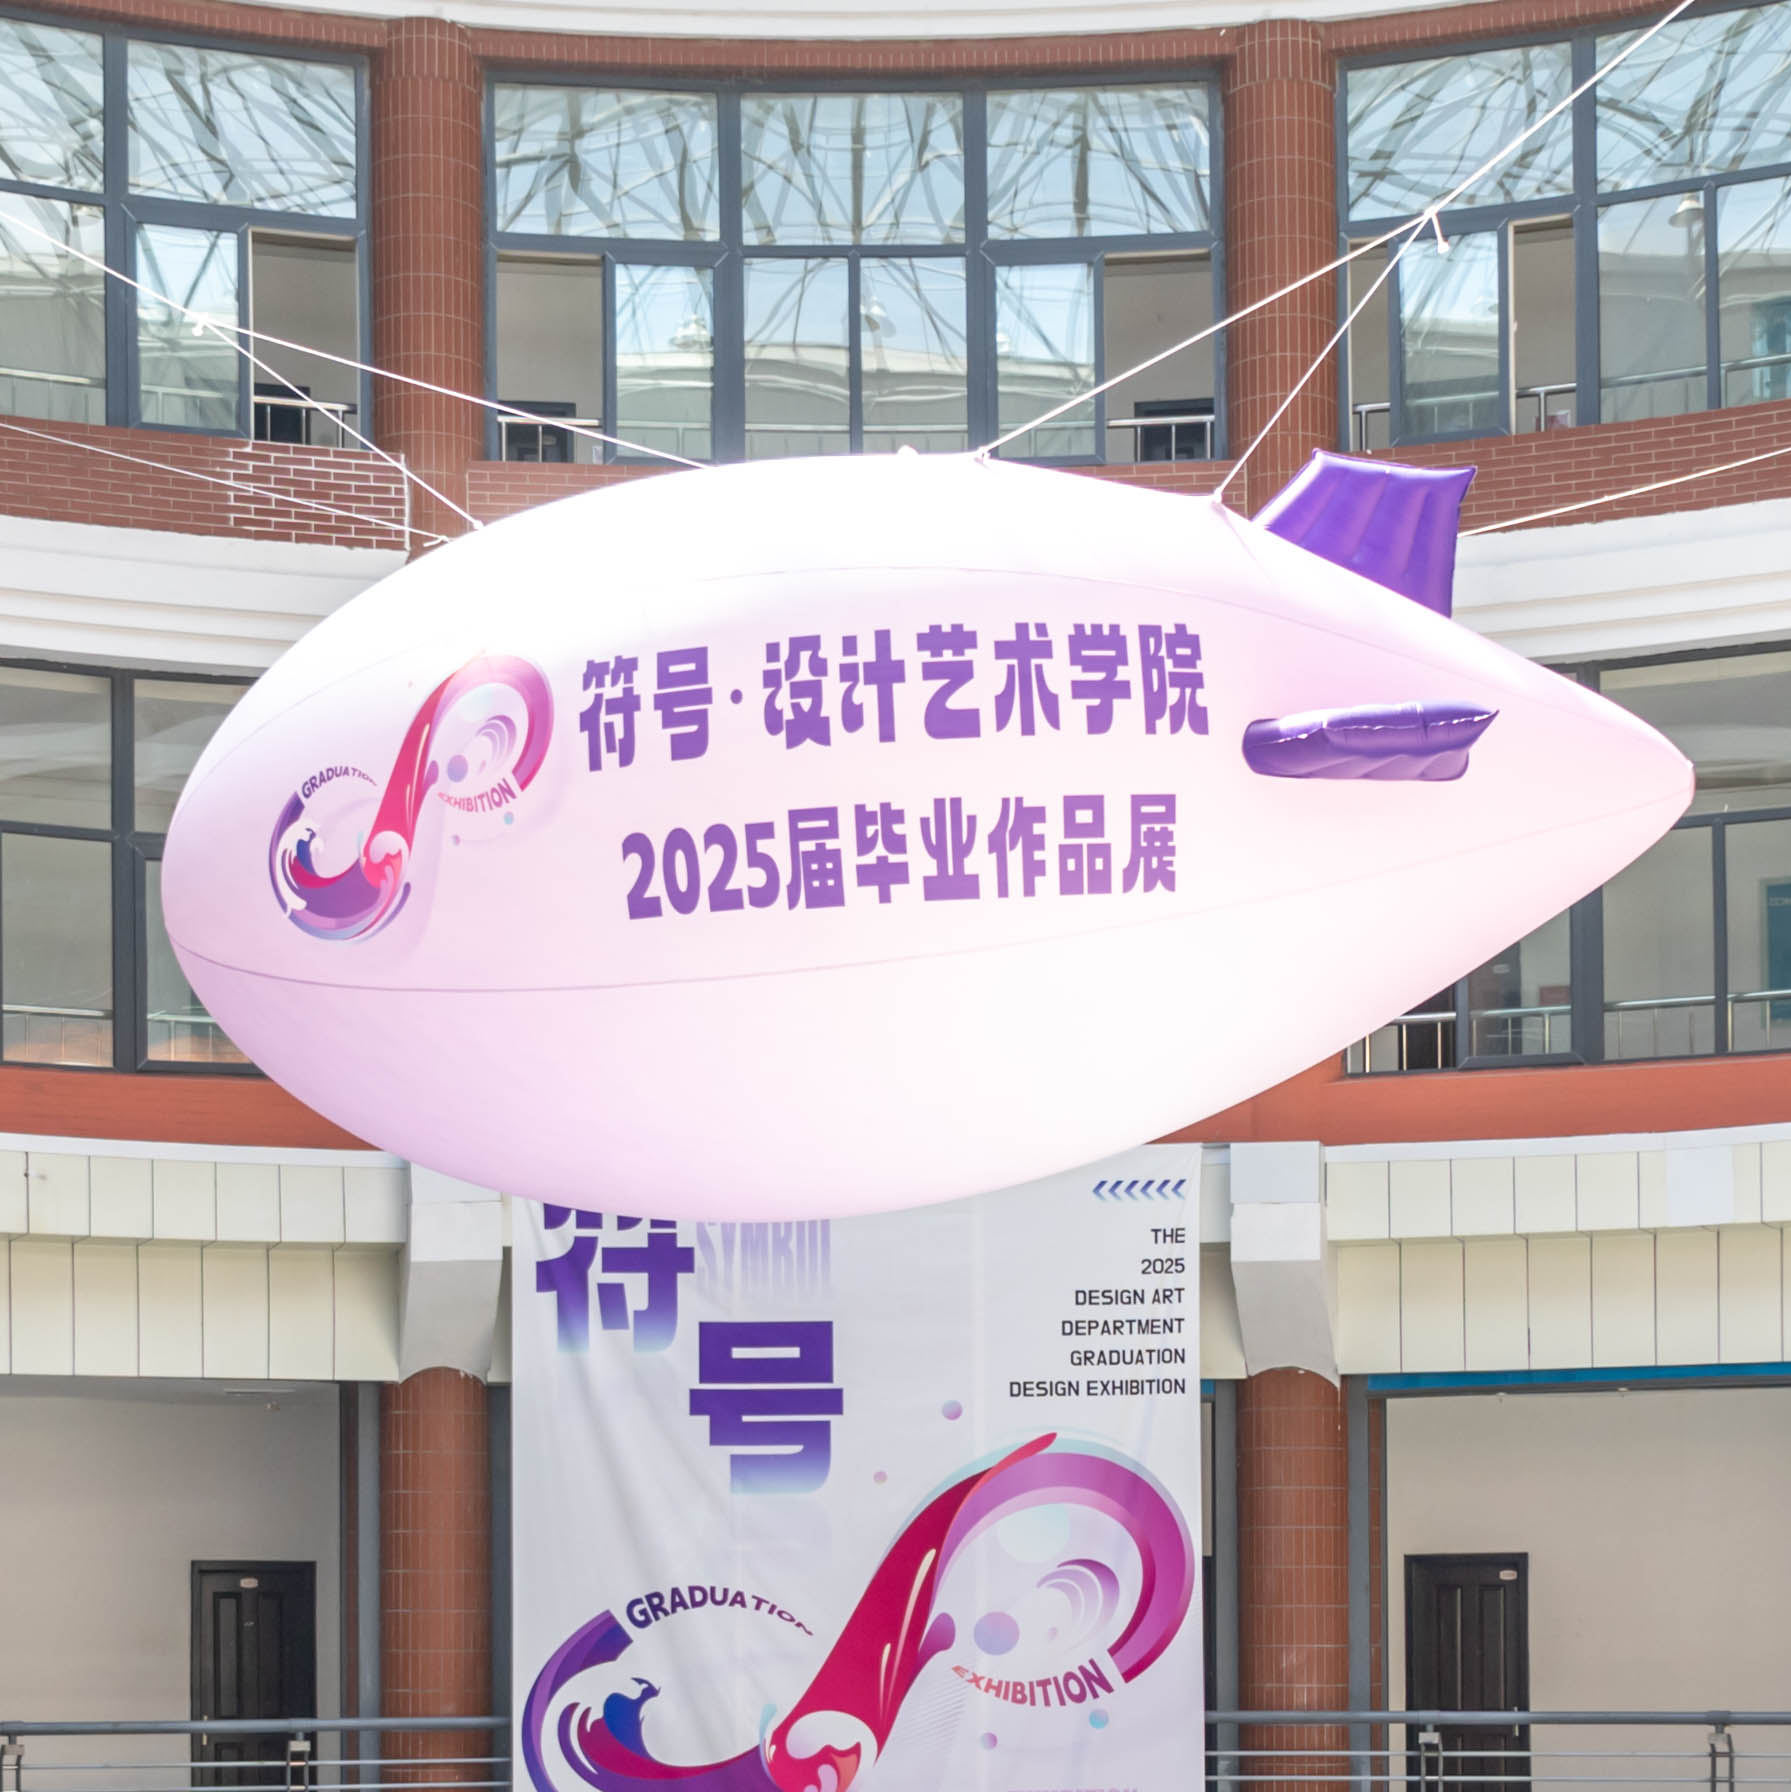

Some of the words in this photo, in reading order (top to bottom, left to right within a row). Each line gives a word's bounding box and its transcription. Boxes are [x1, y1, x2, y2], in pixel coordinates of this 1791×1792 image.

[622, 793, 1177, 918] 2025届毕业作品展
[1151, 1228, 1185, 1244] THE
[1141, 1258, 1185, 1275] 2025
[1075, 1289, 1145, 1306] DESIGN
[1151, 1288, 1185, 1305] ART
[1061, 1318, 1185, 1336] DEPARTMENT
[1070, 1348, 1185, 1367] GRADUATION
[1009, 1380, 1080, 1398] DESIGN
[1086, 1378, 1186, 1396] EXHIBITION
[625, 1585, 814, 1636] GRADUATION
[951, 1658, 1114, 1707] EXHIBITION
